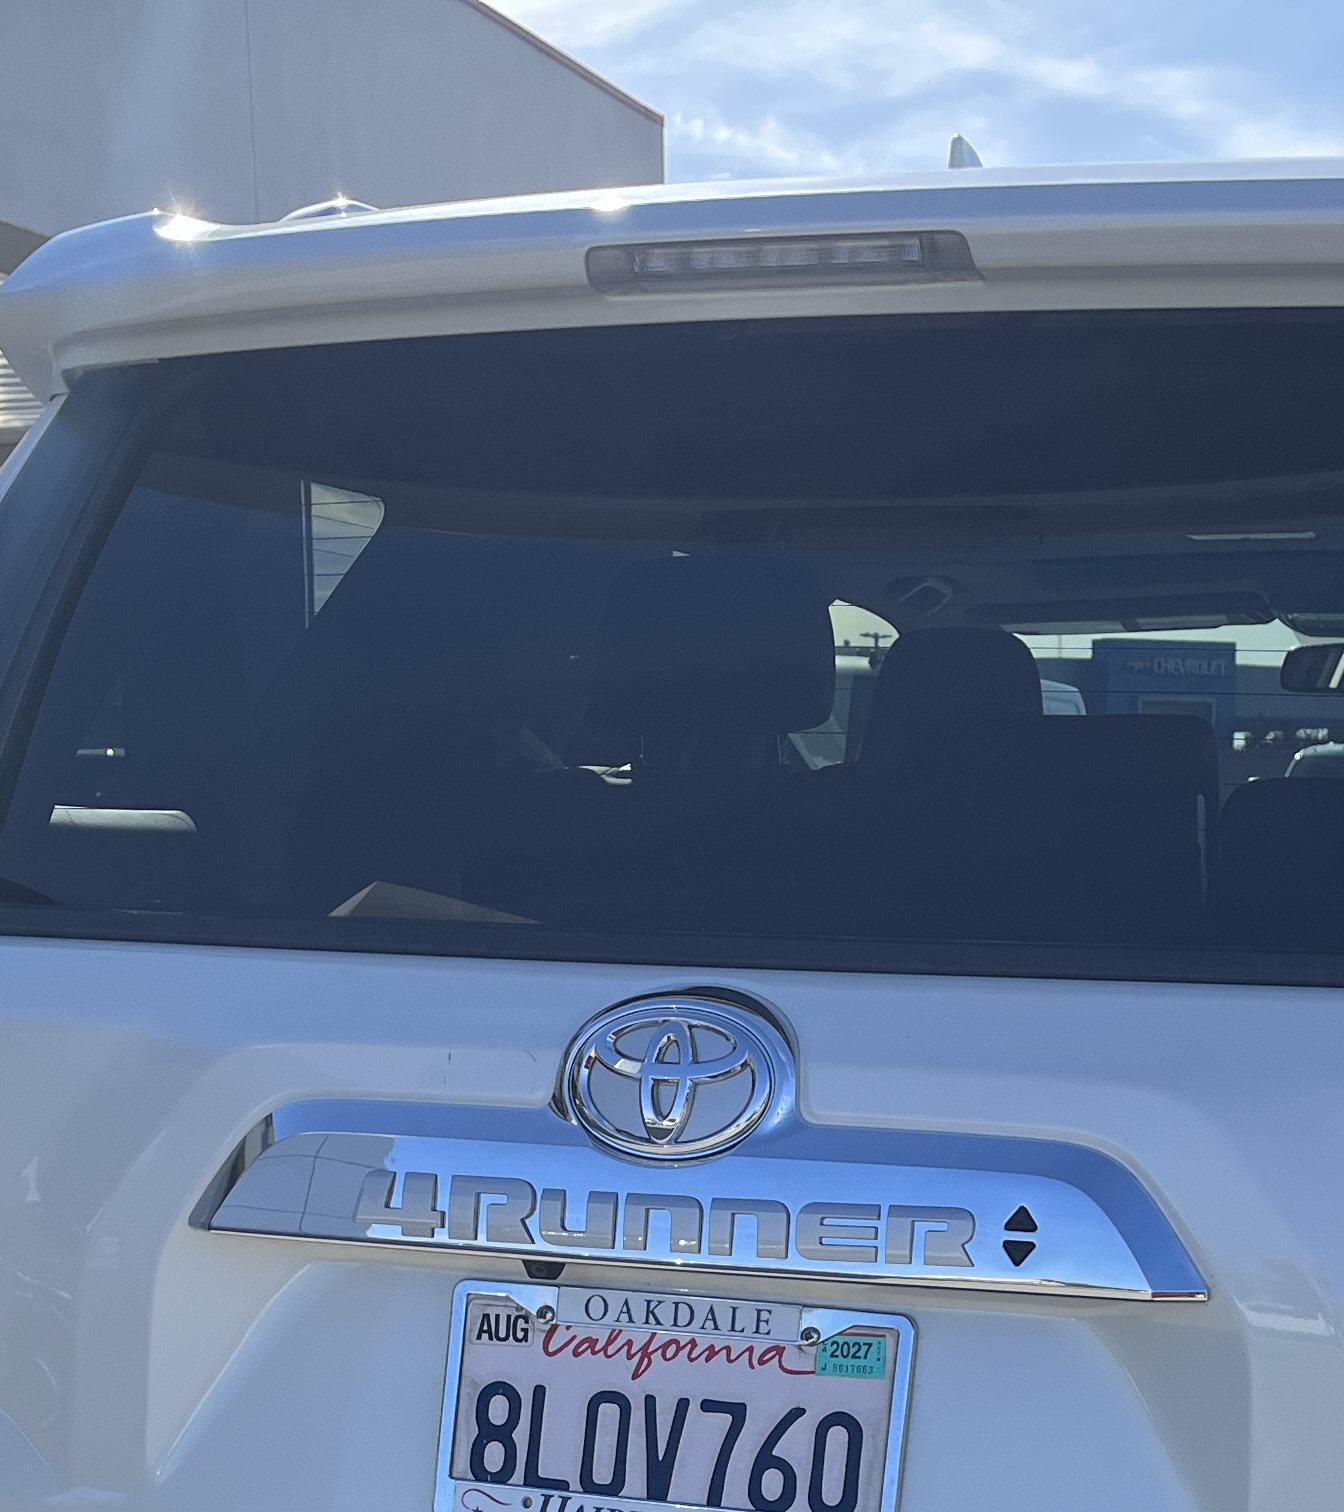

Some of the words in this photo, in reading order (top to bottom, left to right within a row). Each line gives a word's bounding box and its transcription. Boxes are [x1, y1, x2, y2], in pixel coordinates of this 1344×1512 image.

[1153, 657, 1227, 676] CHEVROLET
[357, 1169, 976, 1268] 4RUNNER
[475, 1312, 531, 1344] AUG
[584, 1293, 774, 1337] OAKDALE
[542, 1323, 816, 1381] California
[828, 1340, 874, 1361] 2027
